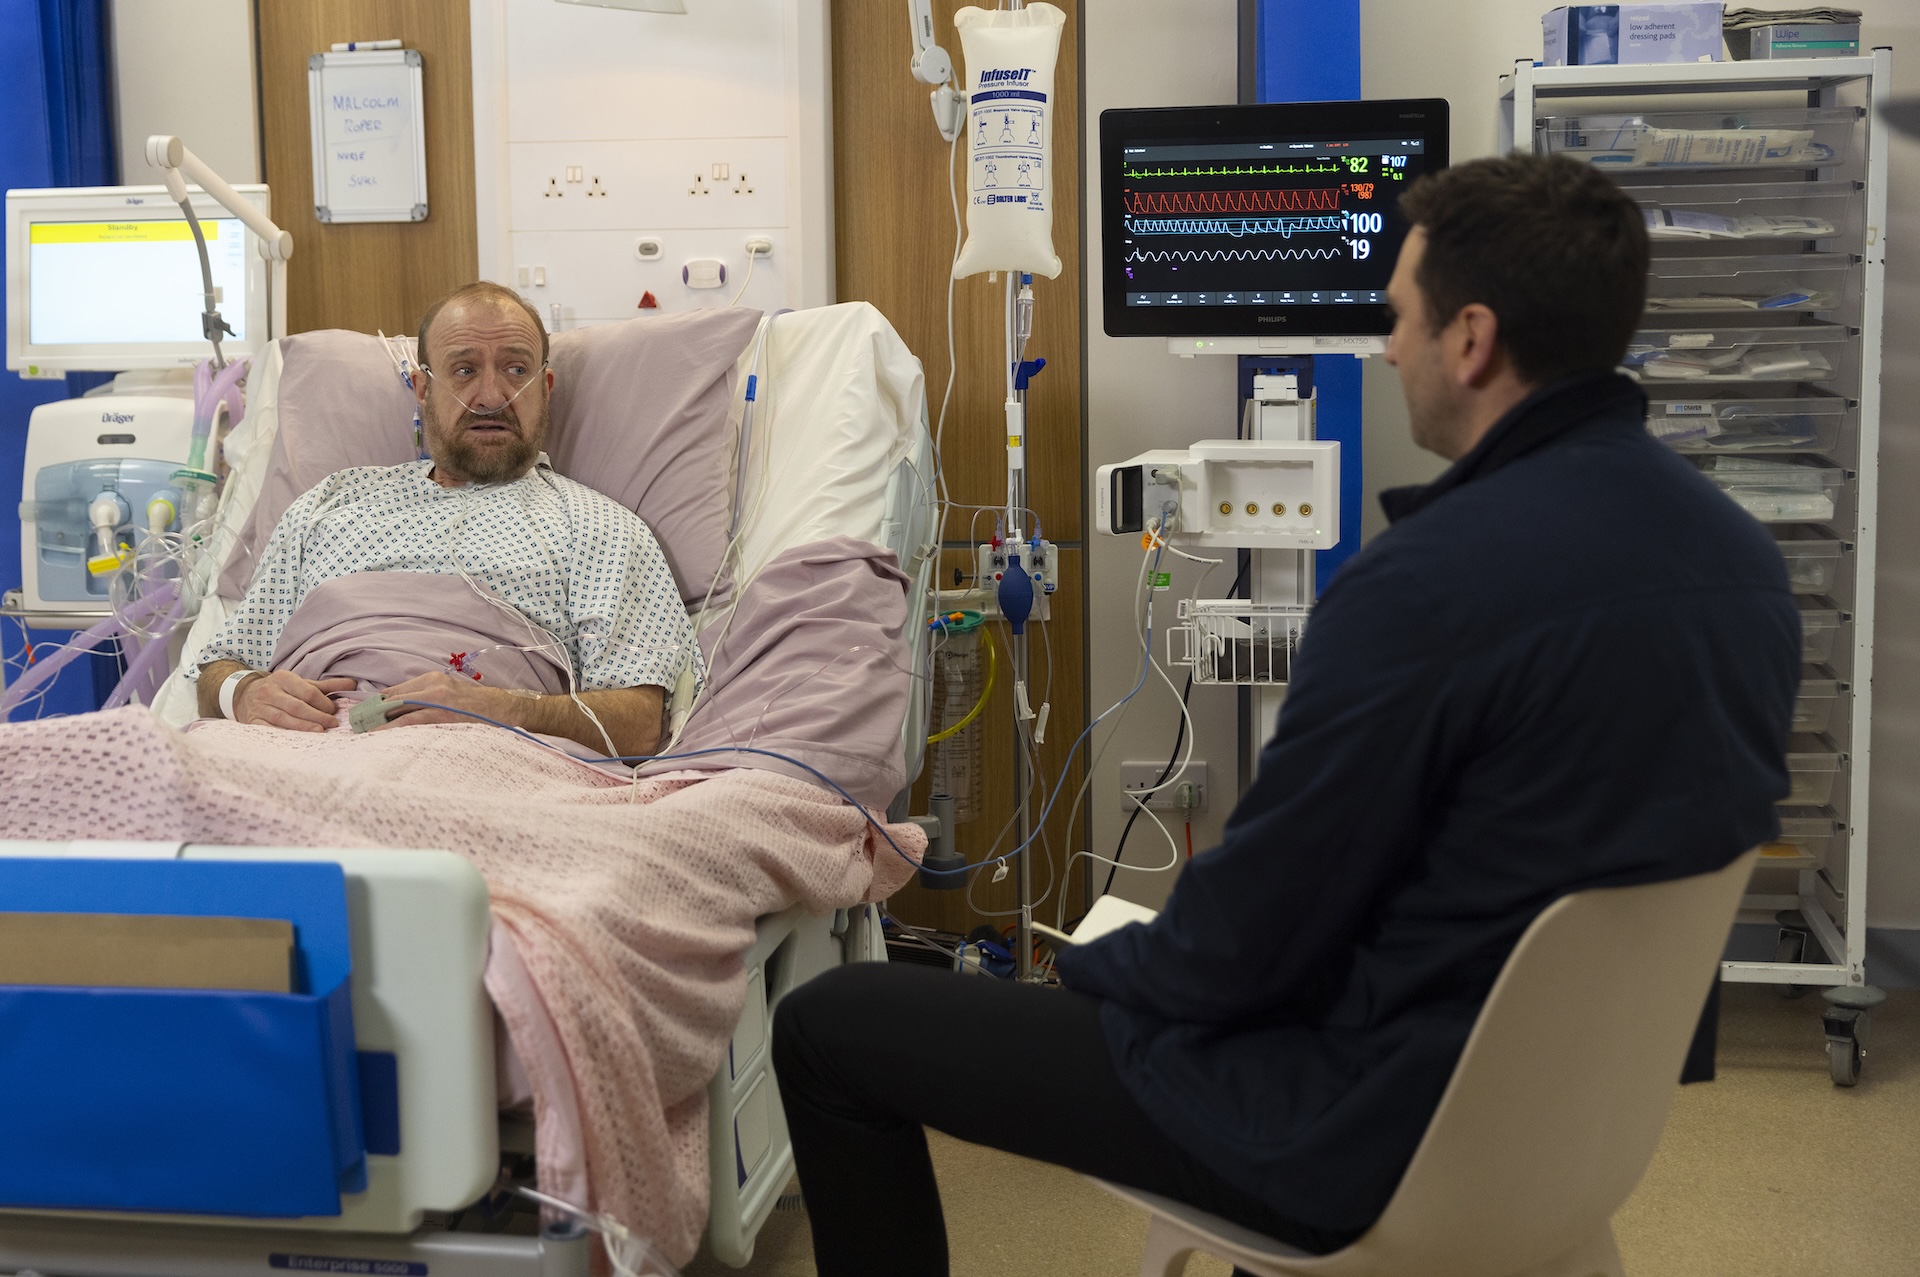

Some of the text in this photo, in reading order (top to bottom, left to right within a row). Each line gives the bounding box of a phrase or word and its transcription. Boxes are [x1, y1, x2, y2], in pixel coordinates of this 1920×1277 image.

[1629, 22, 1675, 31] low adherent
[1629, 31, 1676, 42] dressing pads
[1775, 29, 1800, 40] Wipe
[978, 81, 1005, 89] Pressure
[333, 95, 399, 111] MALCOLM
[345, 118, 382, 134] ROPER
[1350, 156, 1368, 173] 82
[1389, 155, 1407, 168] 107
[1350, 182, 1375, 194] 130/79
[107, 223, 138, 232] Standby
[1350, 212, 1382, 234] 100
[1350, 239, 1371, 260] 19
[101, 412, 135, 424] Dräger
[288, 1255, 370, 1272] Enterprise
